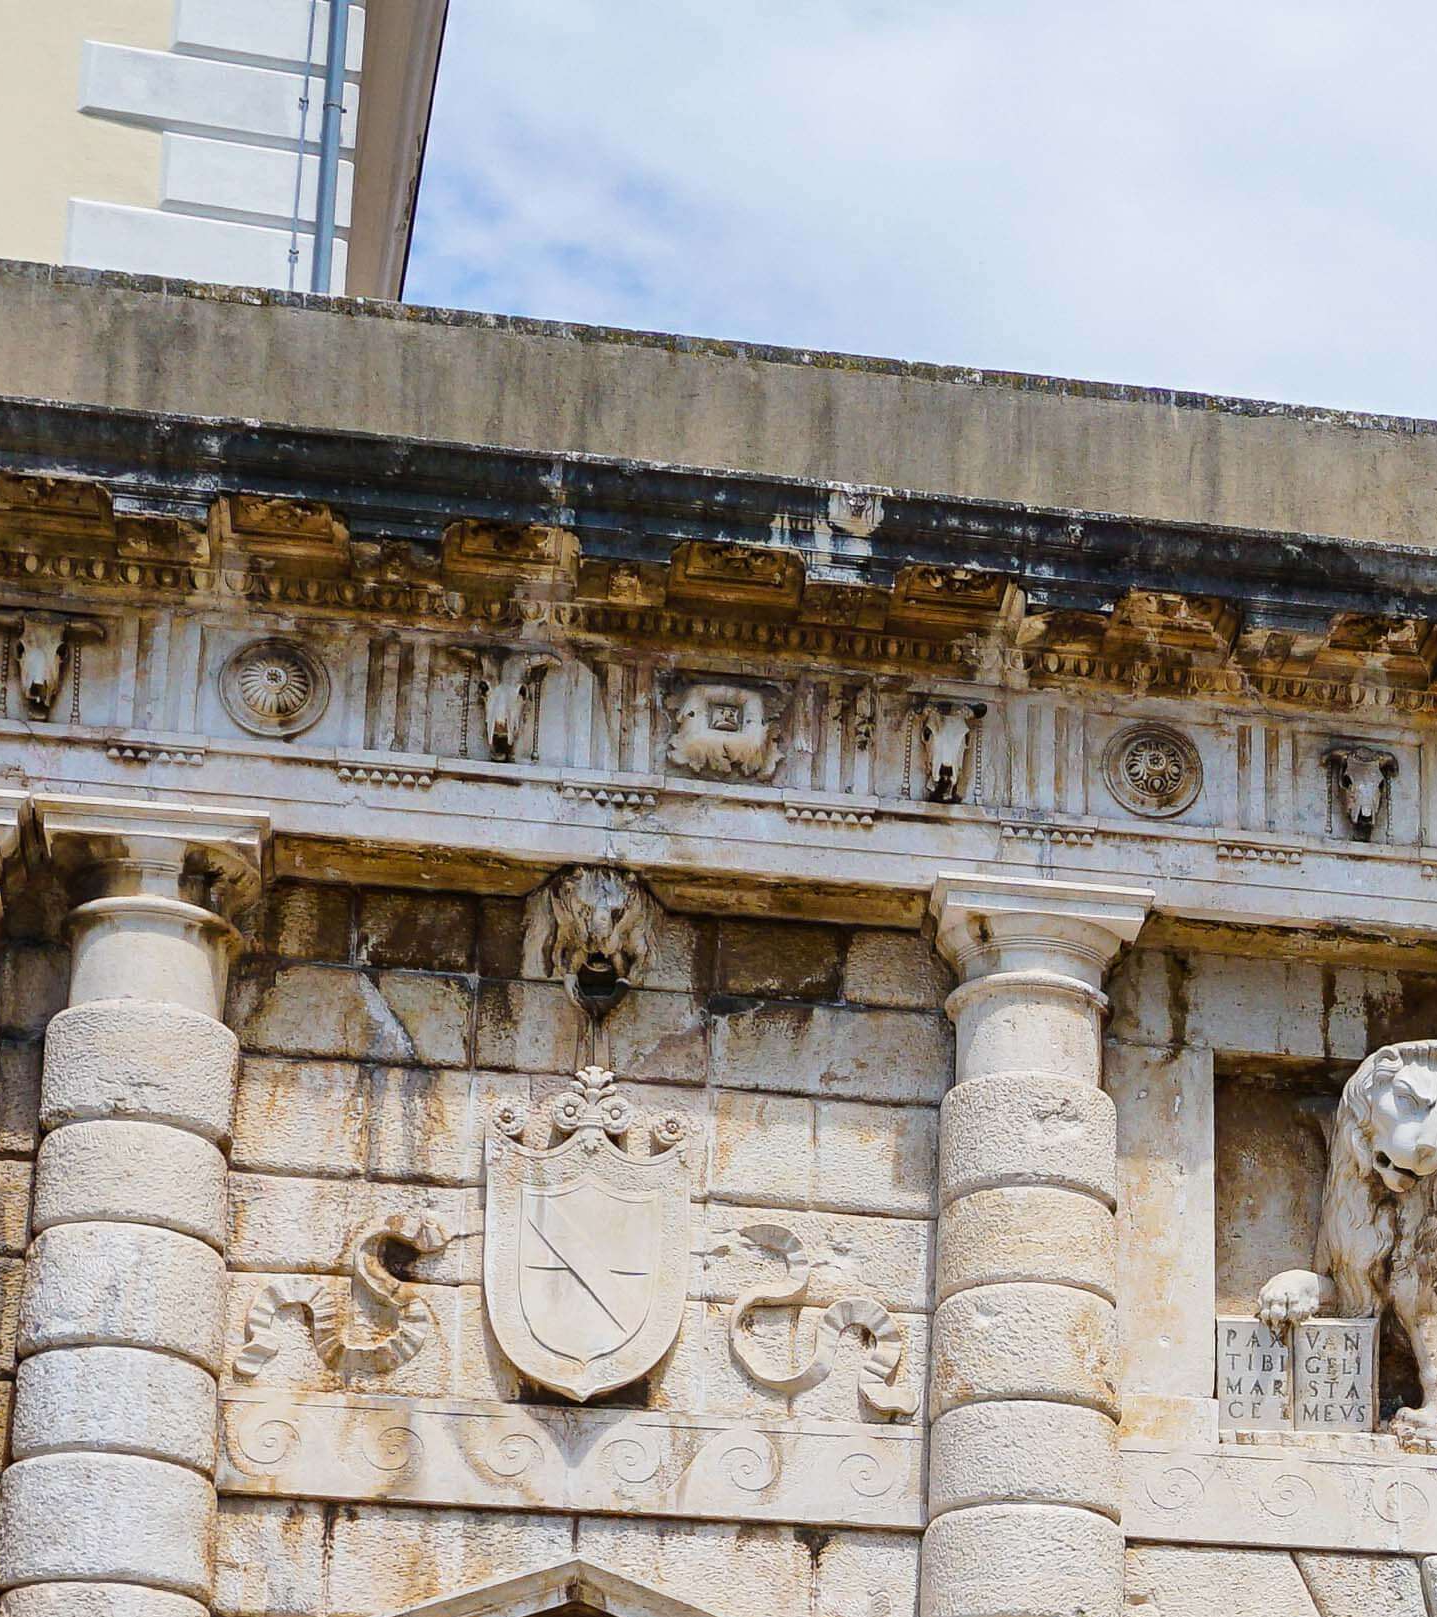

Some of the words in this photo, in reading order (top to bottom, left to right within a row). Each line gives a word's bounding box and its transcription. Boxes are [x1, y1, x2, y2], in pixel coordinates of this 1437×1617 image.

[1226, 1329, 1284, 1348] PAX
[1226, 1353, 1287, 1372] TIBI
[1226, 1378, 1286, 1396] MAR
[1308, 1381, 1360, 1400] STA
[1228, 1400, 1261, 1419] CE
[1303, 1403, 1365, 1423] MEVS
